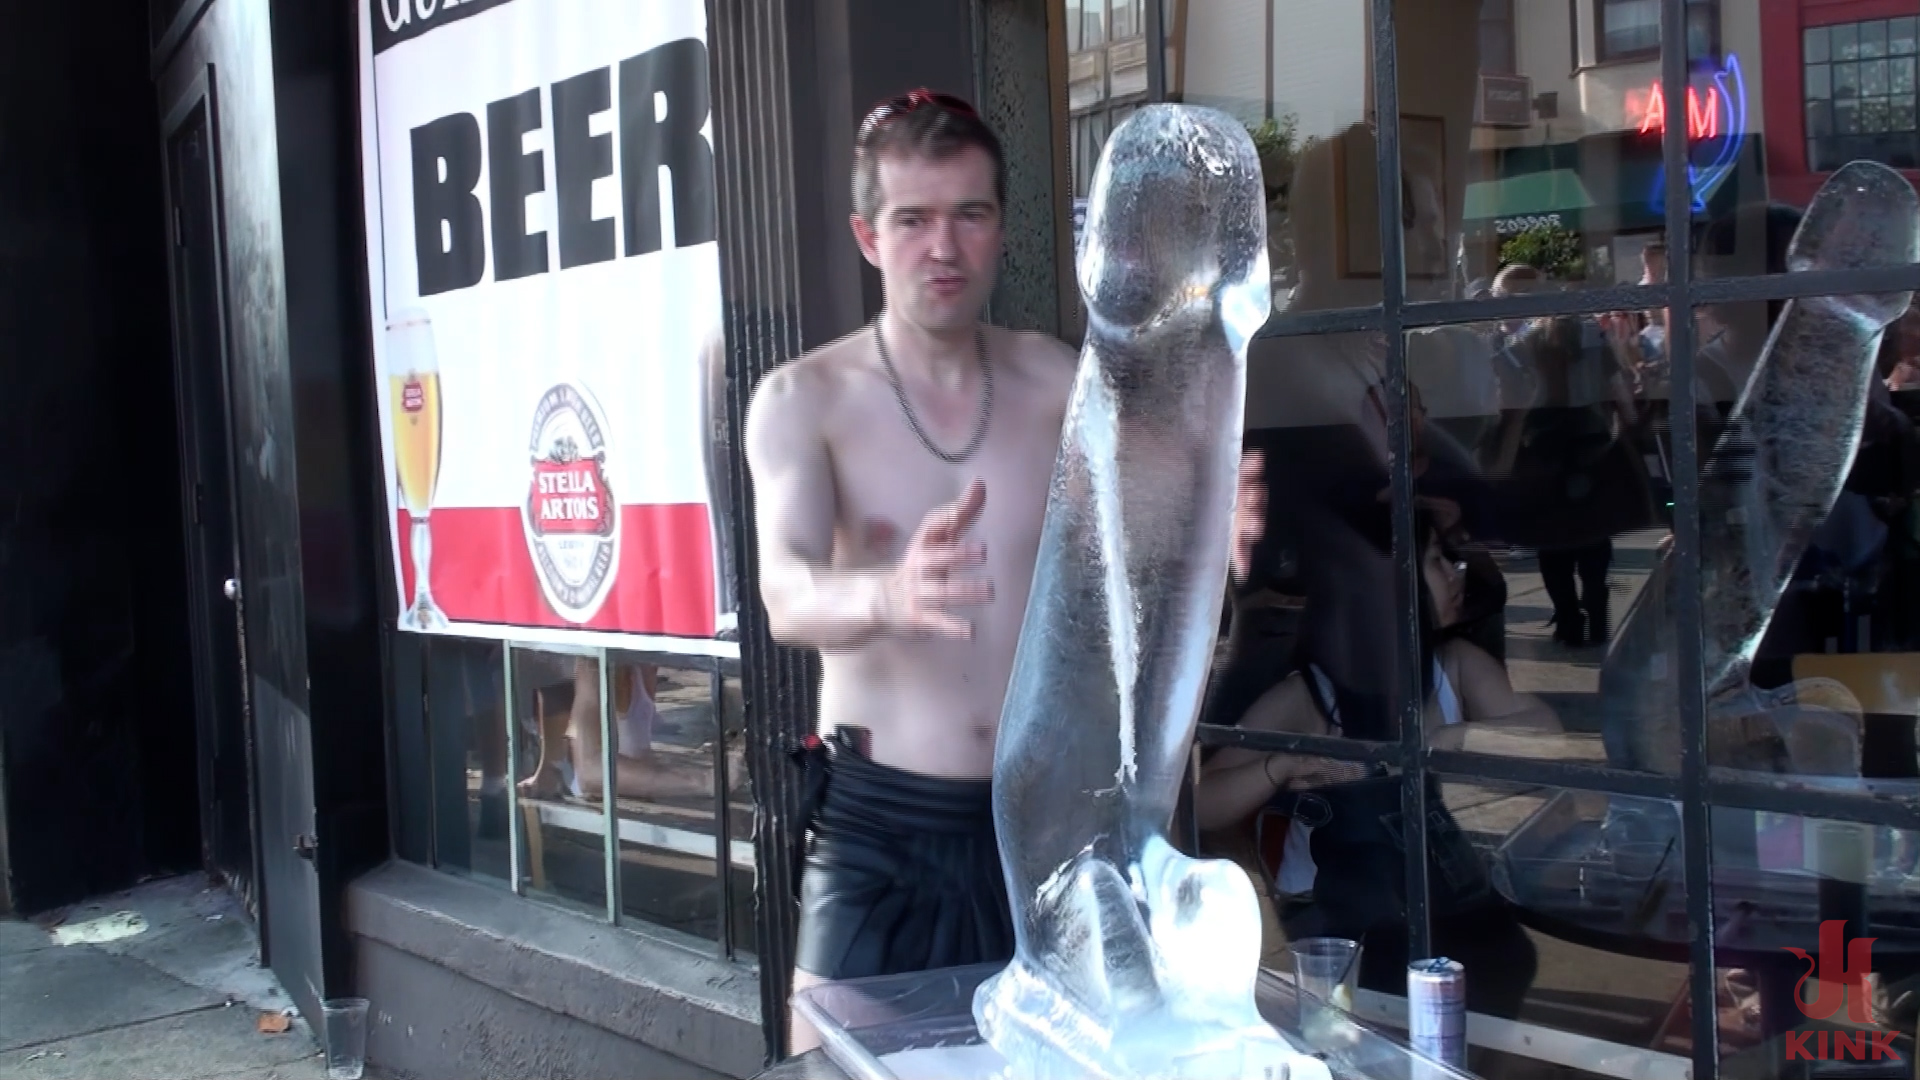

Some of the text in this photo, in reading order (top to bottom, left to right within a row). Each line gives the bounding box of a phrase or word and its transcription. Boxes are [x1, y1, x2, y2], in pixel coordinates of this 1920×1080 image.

[409, 37, 718, 297] BEER
[539, 469, 596, 494] STELLA
[541, 496, 600, 520] ARTOIS
